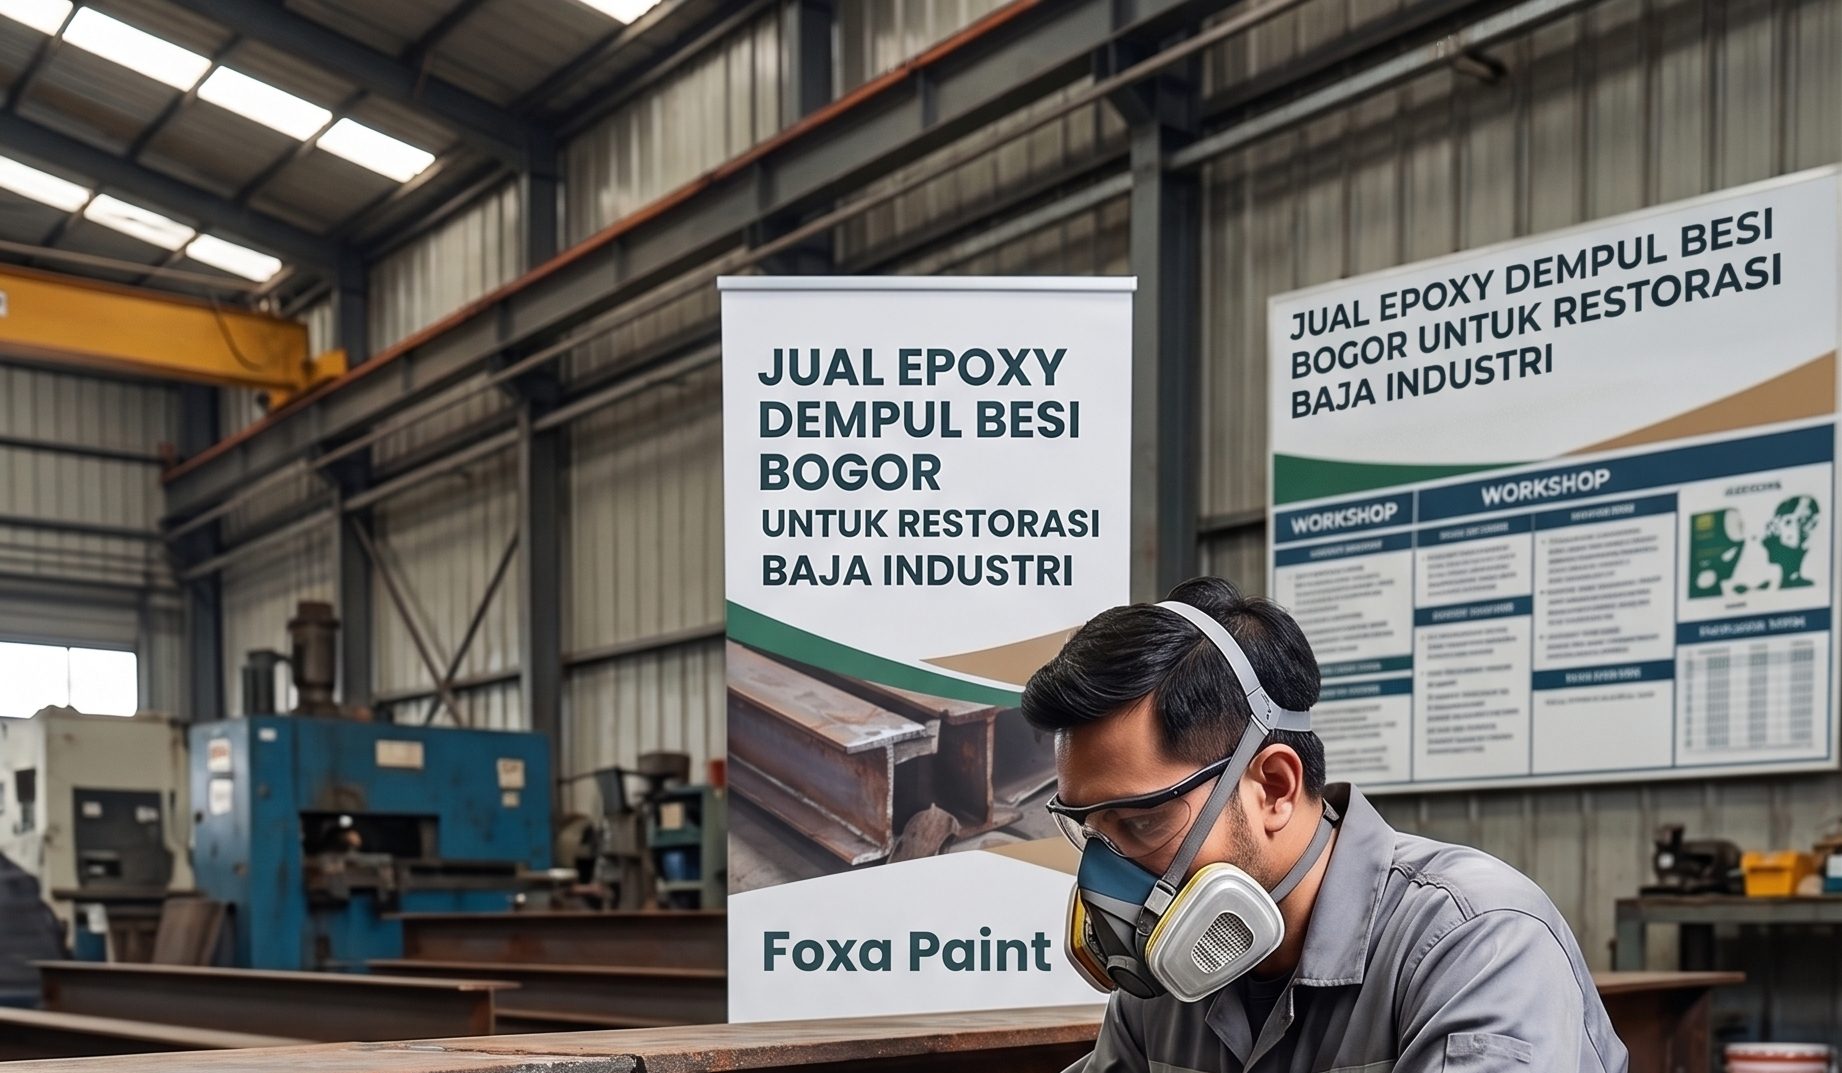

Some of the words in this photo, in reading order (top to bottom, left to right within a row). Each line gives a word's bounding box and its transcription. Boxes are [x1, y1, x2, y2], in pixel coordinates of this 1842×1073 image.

[1290, 302, 1371, 341] JUAL
[1380, 270, 1495, 323] EPOXY
[1505, 233, 1668, 295] DEMPUL
[1681, 207, 1774, 258] BESI
[1291, 330, 1407, 380] BOGOR
[1418, 302, 1541, 355] UNTUK
[1554, 253, 1782, 328] RESTORASI
[758, 347, 884, 386] JUAL
[899, 347, 1067, 386] EPOXY
[1291, 379, 1376, 419] BAJA
[1386, 343, 1553, 402] INDUSTRI
[759, 400, 962, 439] DEMPUL
[977, 400, 1079, 439] BESI
[759, 452, 941, 492] BOGOR
[1482, 468, 1611, 508] WORKSHOP
[762, 509, 888, 538] UNTUK
[899, 509, 1100, 538] RESTORASI
[1291, 502, 1398, 535] WORKSHOP
[762, 554, 872, 586] BAJA
[884, 554, 1073, 586] INDUSTRI
[763, 931, 892, 972] Foxa
[909, 926, 1052, 972] Paint
